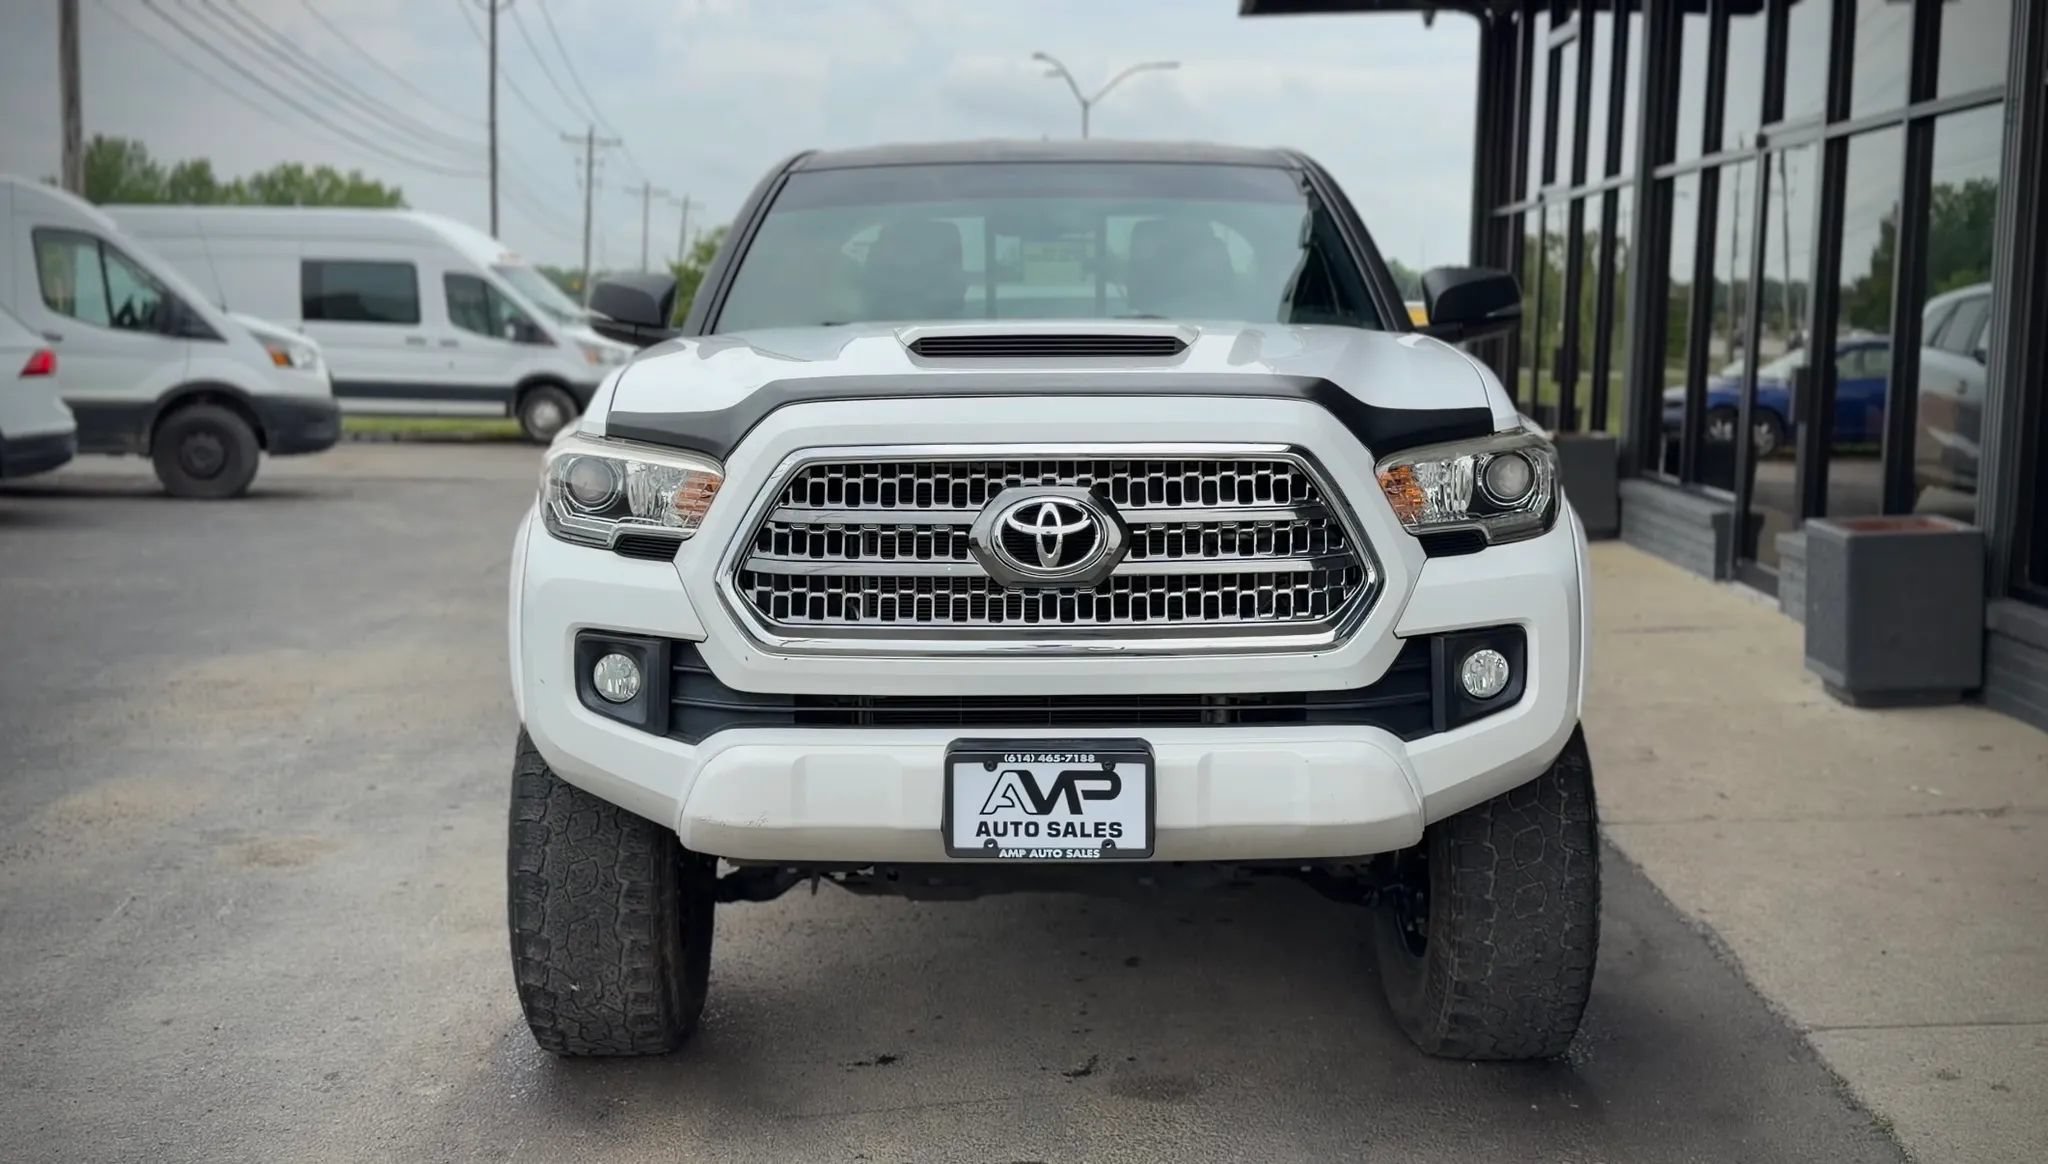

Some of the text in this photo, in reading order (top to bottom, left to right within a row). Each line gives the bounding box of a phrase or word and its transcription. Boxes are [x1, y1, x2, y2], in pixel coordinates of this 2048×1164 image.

[1003, 753, 1096, 763] (614) 465-7188
[979, 769, 1122, 815] AMP
[975, 820, 1123, 838] AUTO SALES
[998, 849, 1101, 858] AMP AUTO SALES
